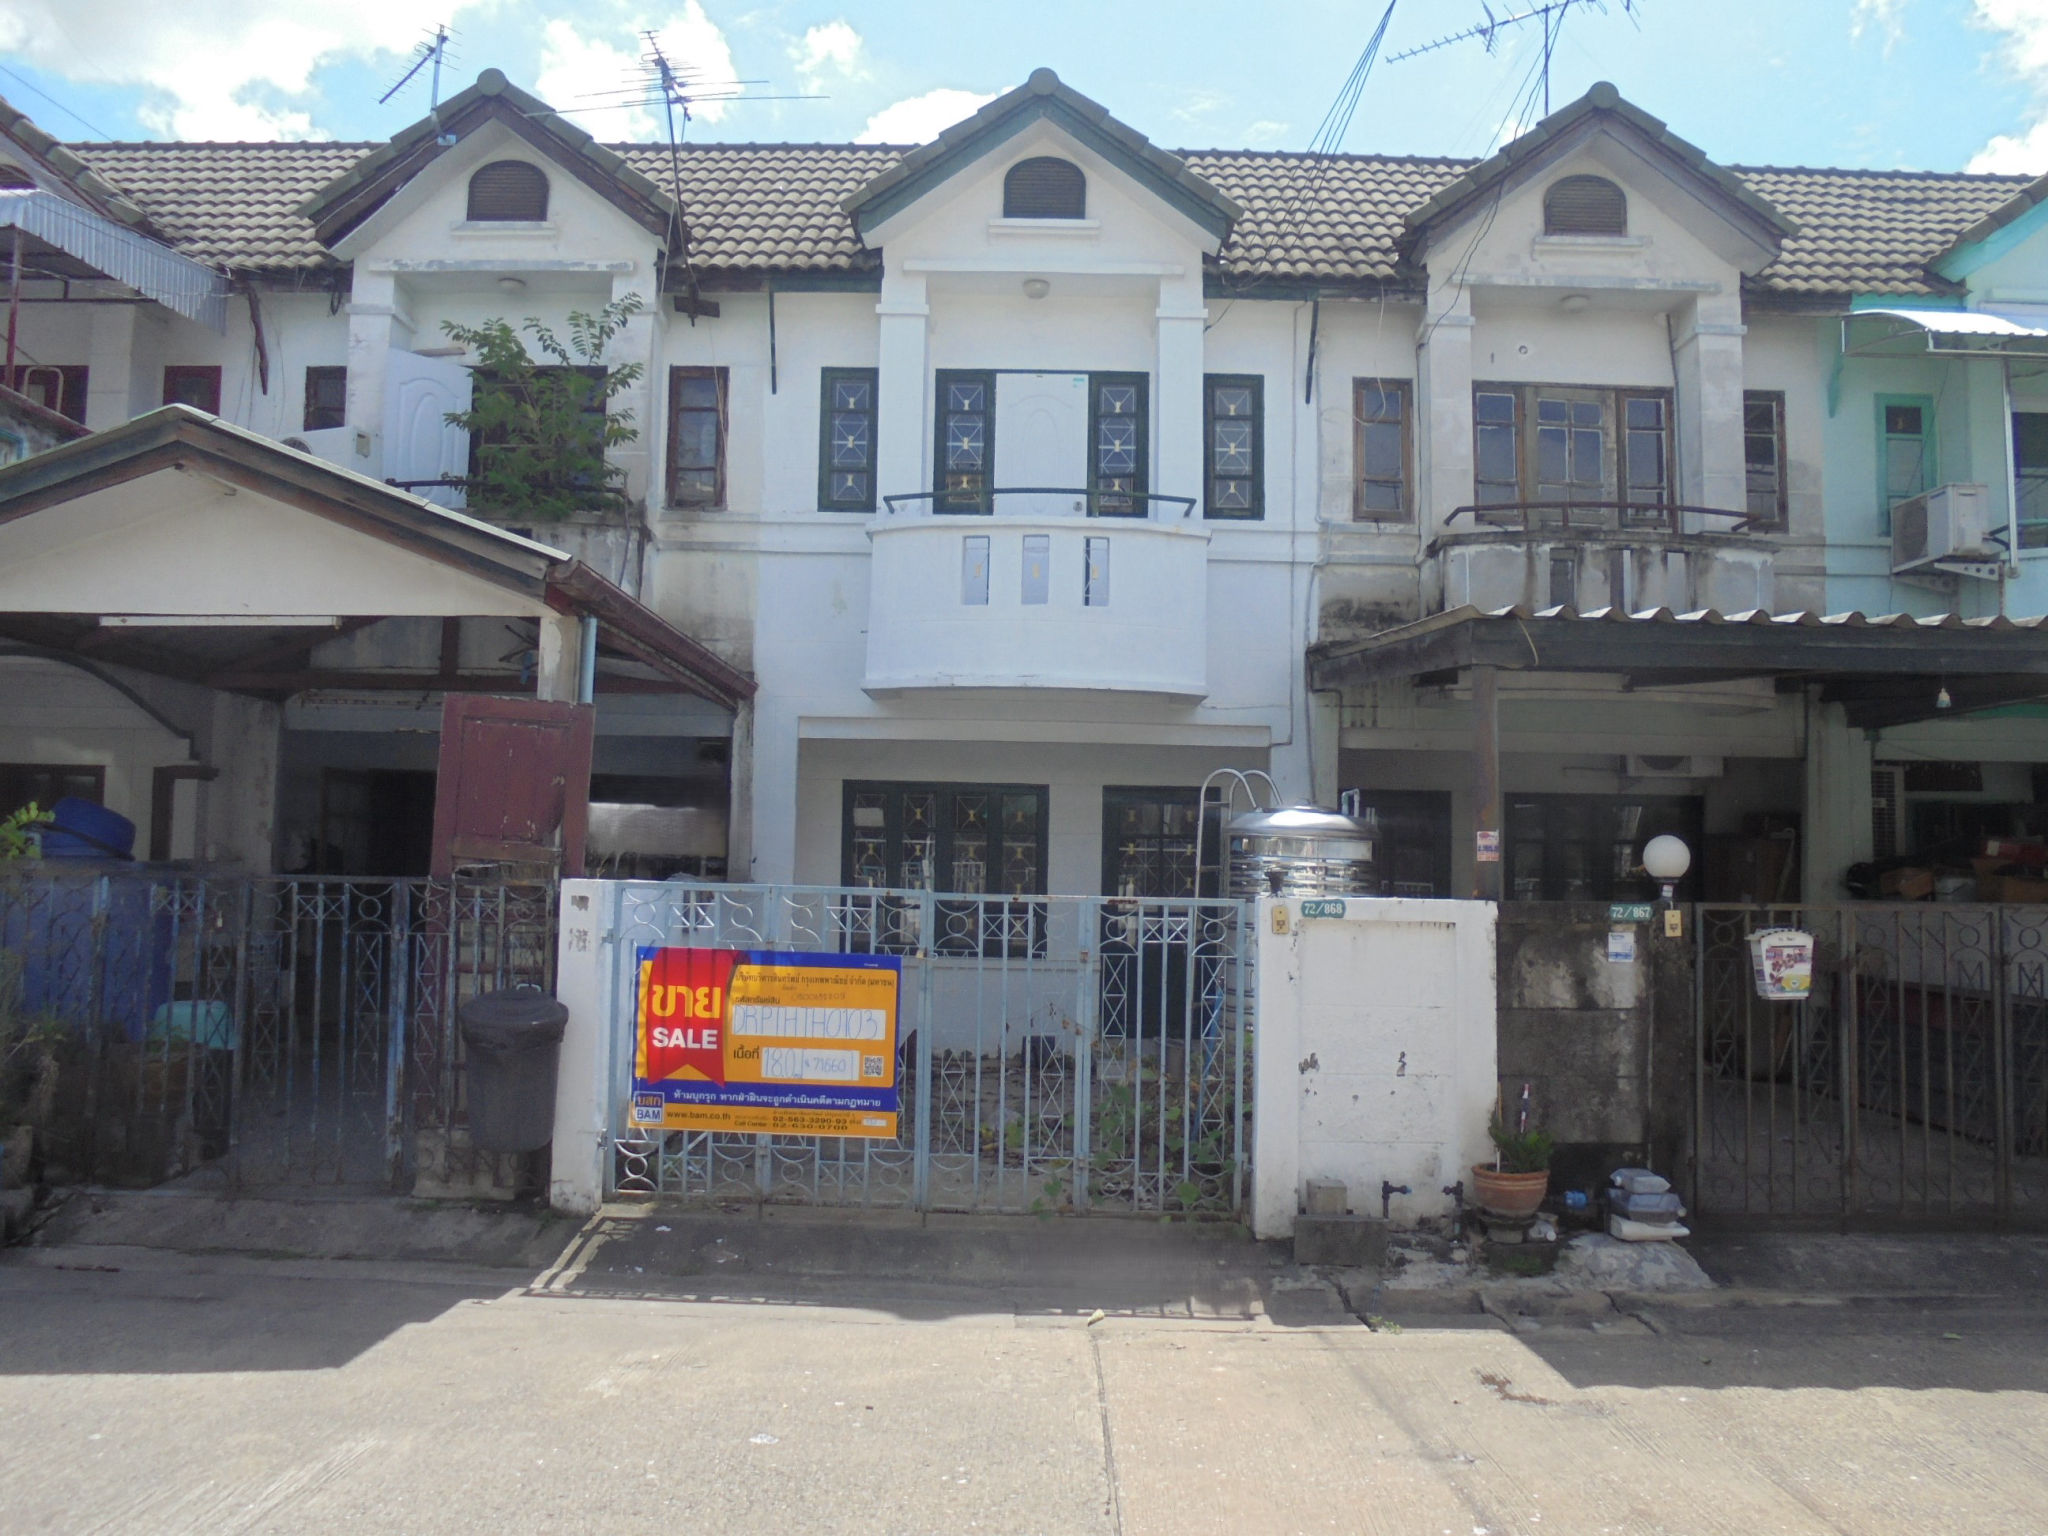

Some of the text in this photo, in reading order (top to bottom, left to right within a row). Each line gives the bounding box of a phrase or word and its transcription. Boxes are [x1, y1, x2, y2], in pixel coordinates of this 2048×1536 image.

[1304, 903, 1343, 915] 72/868
[1611, 906, 1651, 918] 72/867
[652, 984, 721, 1019] ขาย
[652, 1027, 718, 1050] SALE
[733, 1045, 760, 1060] เนื้อที่
[673, 1089, 717, 1103] ห้ามบุกรุก
[636, 1108, 661, 1120] BAM
[667, 1111, 731, 1121] www.bam.co.th
